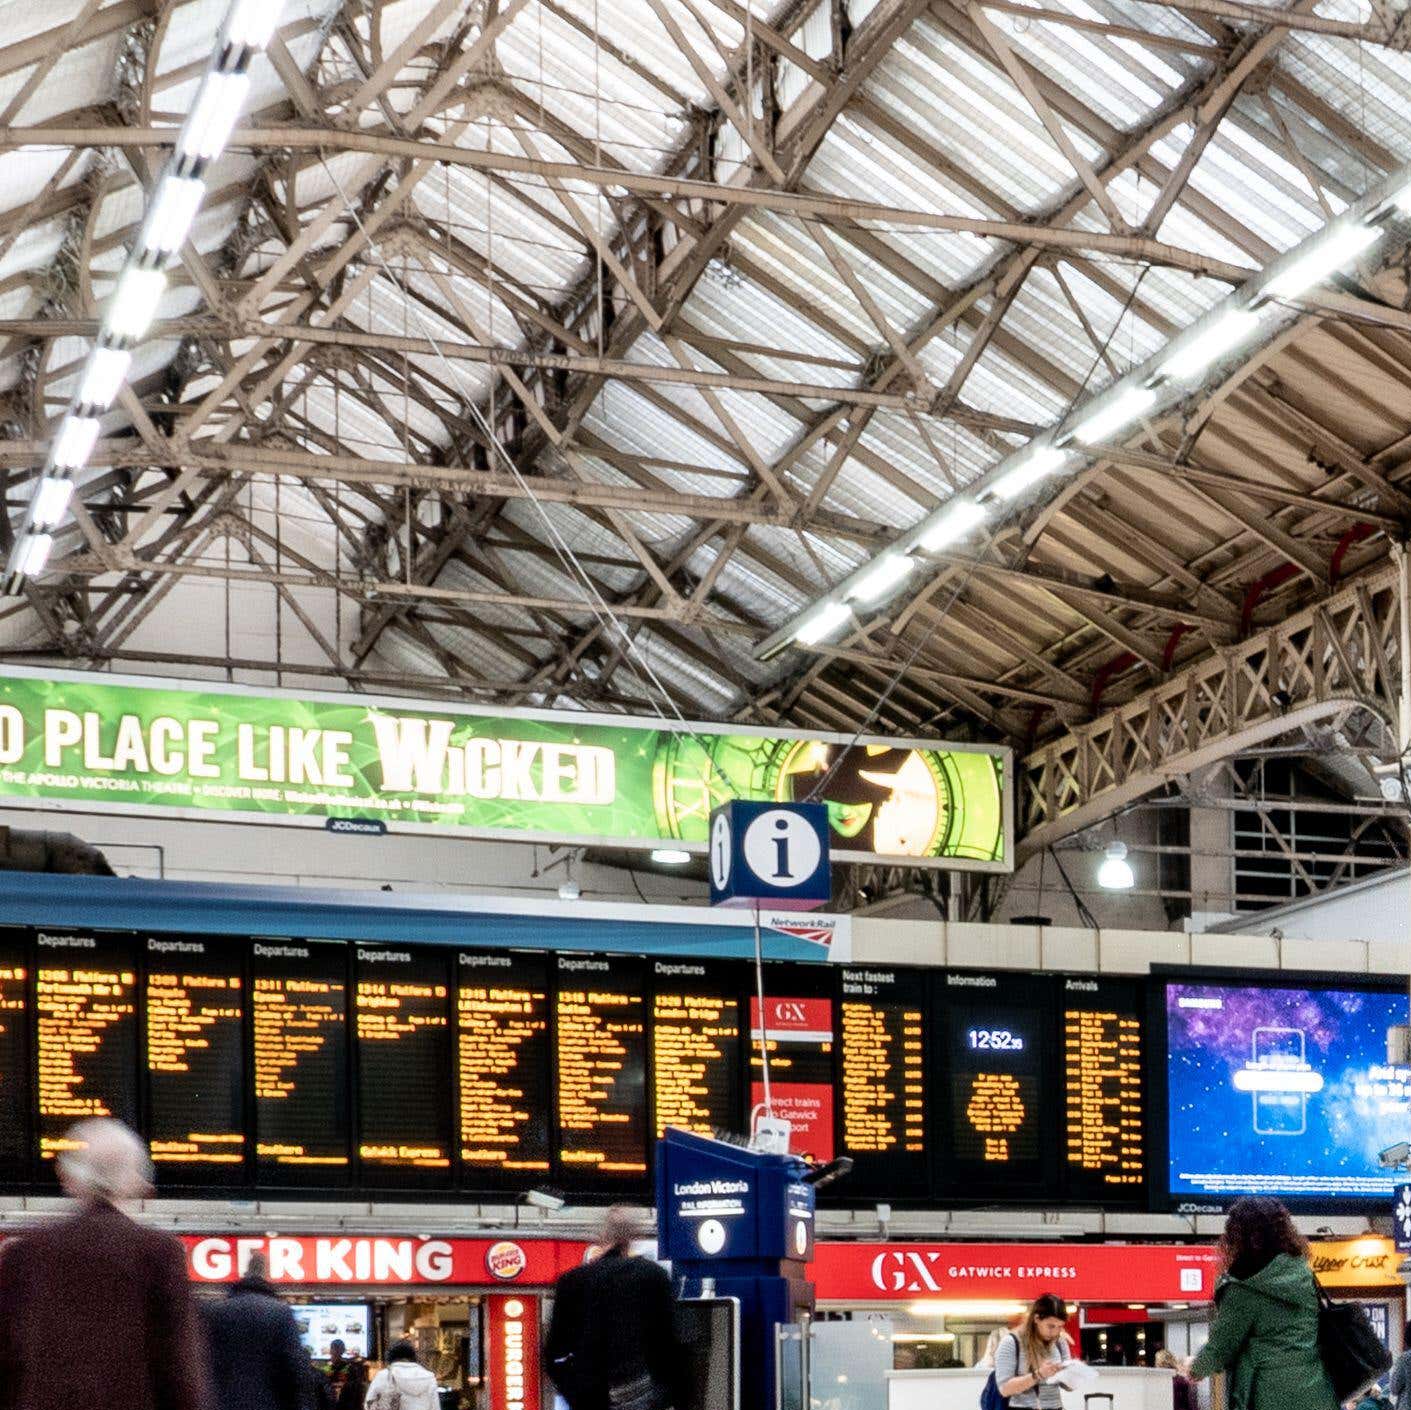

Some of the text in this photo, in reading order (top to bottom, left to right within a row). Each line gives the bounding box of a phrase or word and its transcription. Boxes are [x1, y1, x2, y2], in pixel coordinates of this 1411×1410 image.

[45, 708, 221, 777] PLACE
[238, 723, 354, 787] LIKE
[331, 820, 381, 834] JCDecaux
[38, 933, 96, 948] Departures
[148, 939, 204, 953] Departures
[254, 943, 309, 958] Departures
[358, 949, 411, 963] Departures
[459, 953, 512, 967] Departures
[558, 957, 609, 971] Departures
[655, 962, 705, 976] Departures
[842, 970, 895, 984] Next fastest
[947, 974, 997, 988] Information
[843, 983, 863, 995] train
[864, 984, 873, 995] to
[1065, 979, 1099, 992] Arrivals
[775, 1003, 807, 1022] GX
[794, 1098, 821, 1109] trains
[779, 1109, 818, 1121] Gatwick
[674, 1180, 749, 1197] London Victoria
[1177, 1203, 1223, 1214] JCDecaux
[316, 1237, 454, 1282] KING
[1350, 1254, 1390, 1269] Crust
[871, 1251, 1077, 1292] GX GATWICK EXPRESS
[504, 1320, 524, 1400] BURGER
